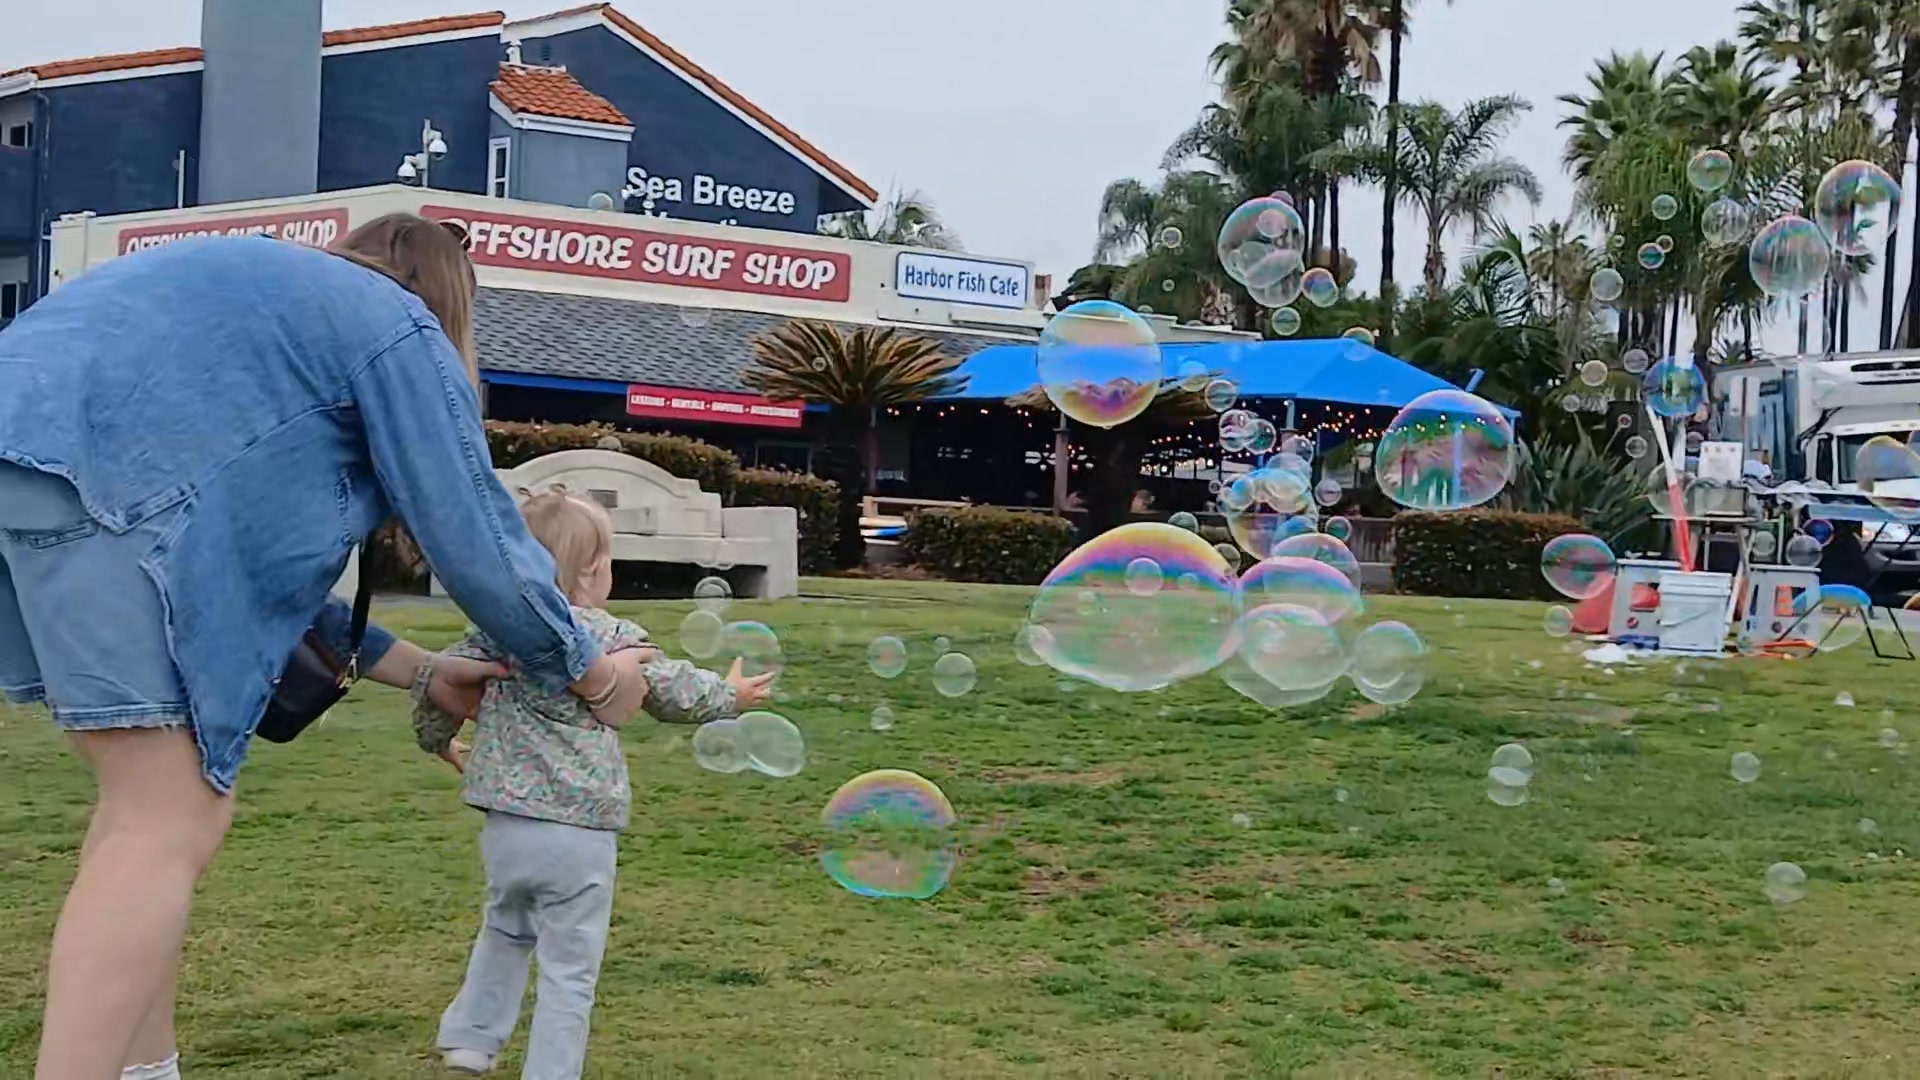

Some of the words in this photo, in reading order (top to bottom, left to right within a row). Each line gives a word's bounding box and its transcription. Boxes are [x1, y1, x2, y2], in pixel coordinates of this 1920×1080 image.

[627, 167, 682, 202] Sea
[693, 175, 795, 214] Breeze
[282, 218, 337, 249] SHOP
[641, 241, 735, 280] SURF
[742, 253, 836, 290] SHOP
[905, 265, 953, 288] Harbor
[958, 271, 985, 292] Fish
[990, 276, 1019, 297] Cafe
